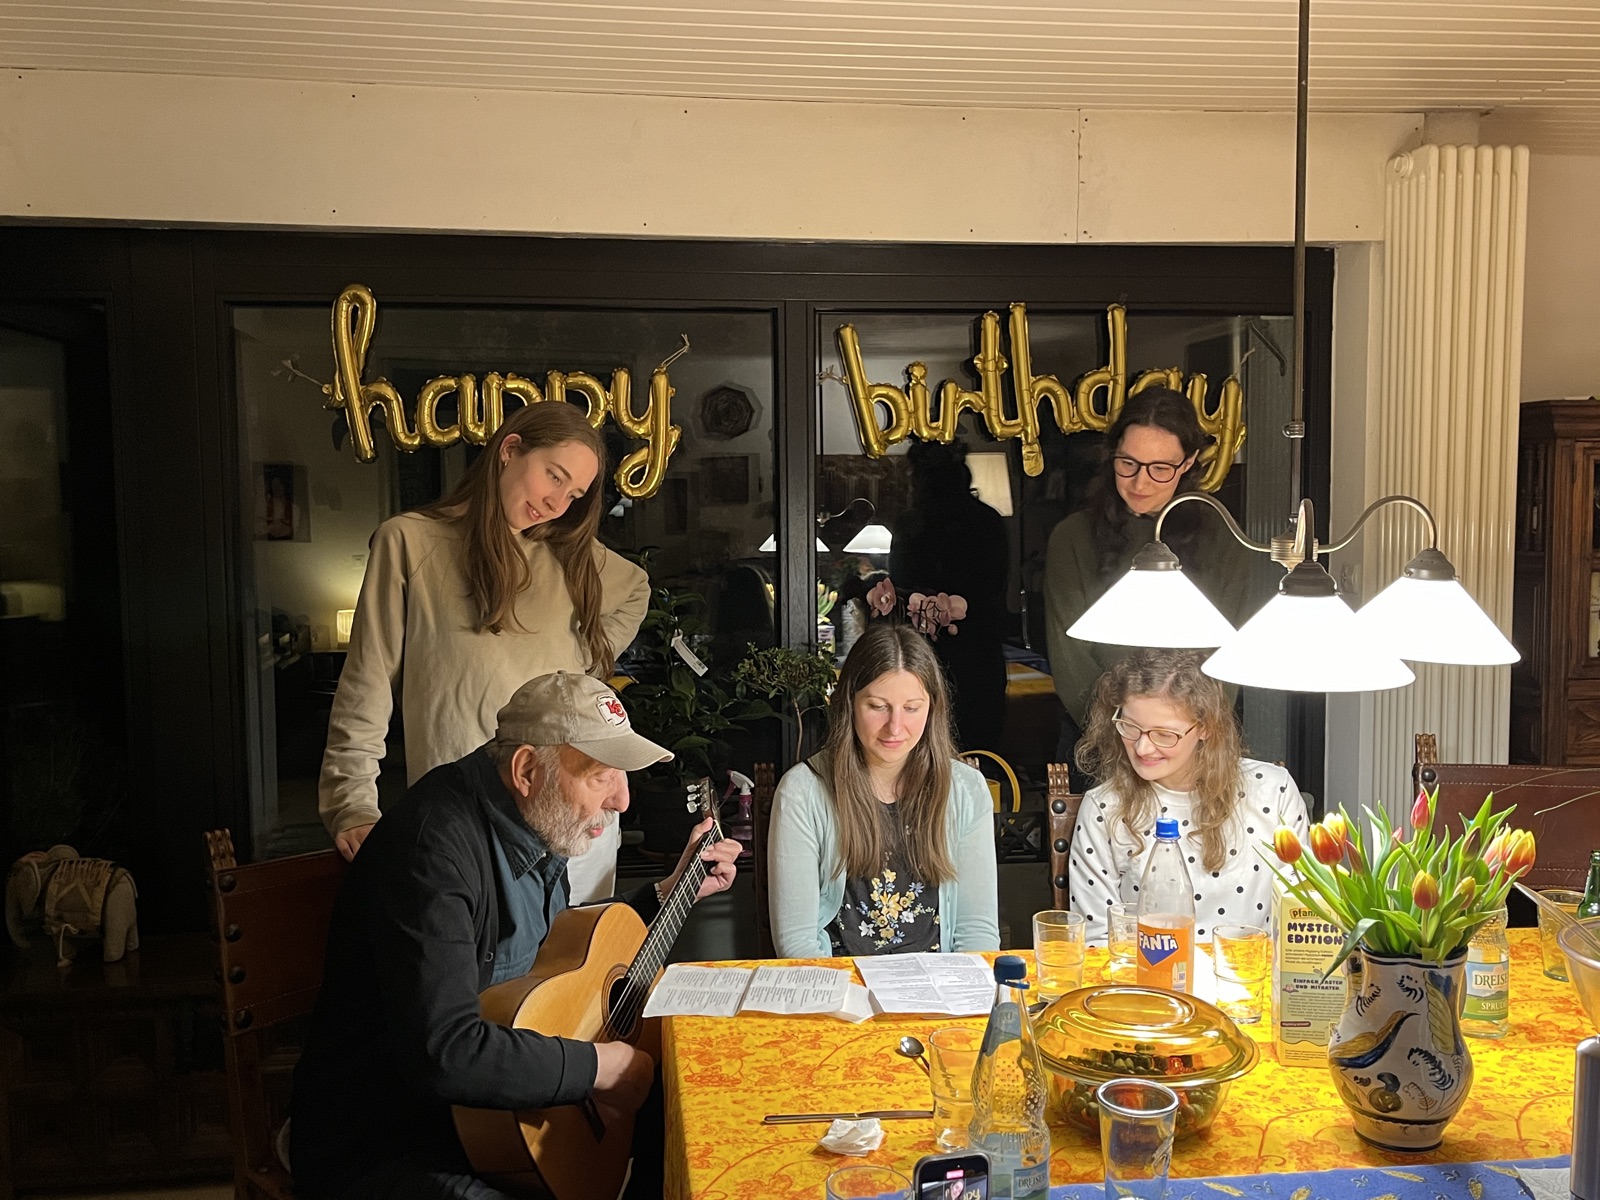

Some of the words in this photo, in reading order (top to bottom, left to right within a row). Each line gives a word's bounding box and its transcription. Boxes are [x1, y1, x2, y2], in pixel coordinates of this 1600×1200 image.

[1287, 922, 1340, 934] MYSTER
[1139, 930, 1178, 951] FANTA
[1287, 933, 1343, 945] EDITION
